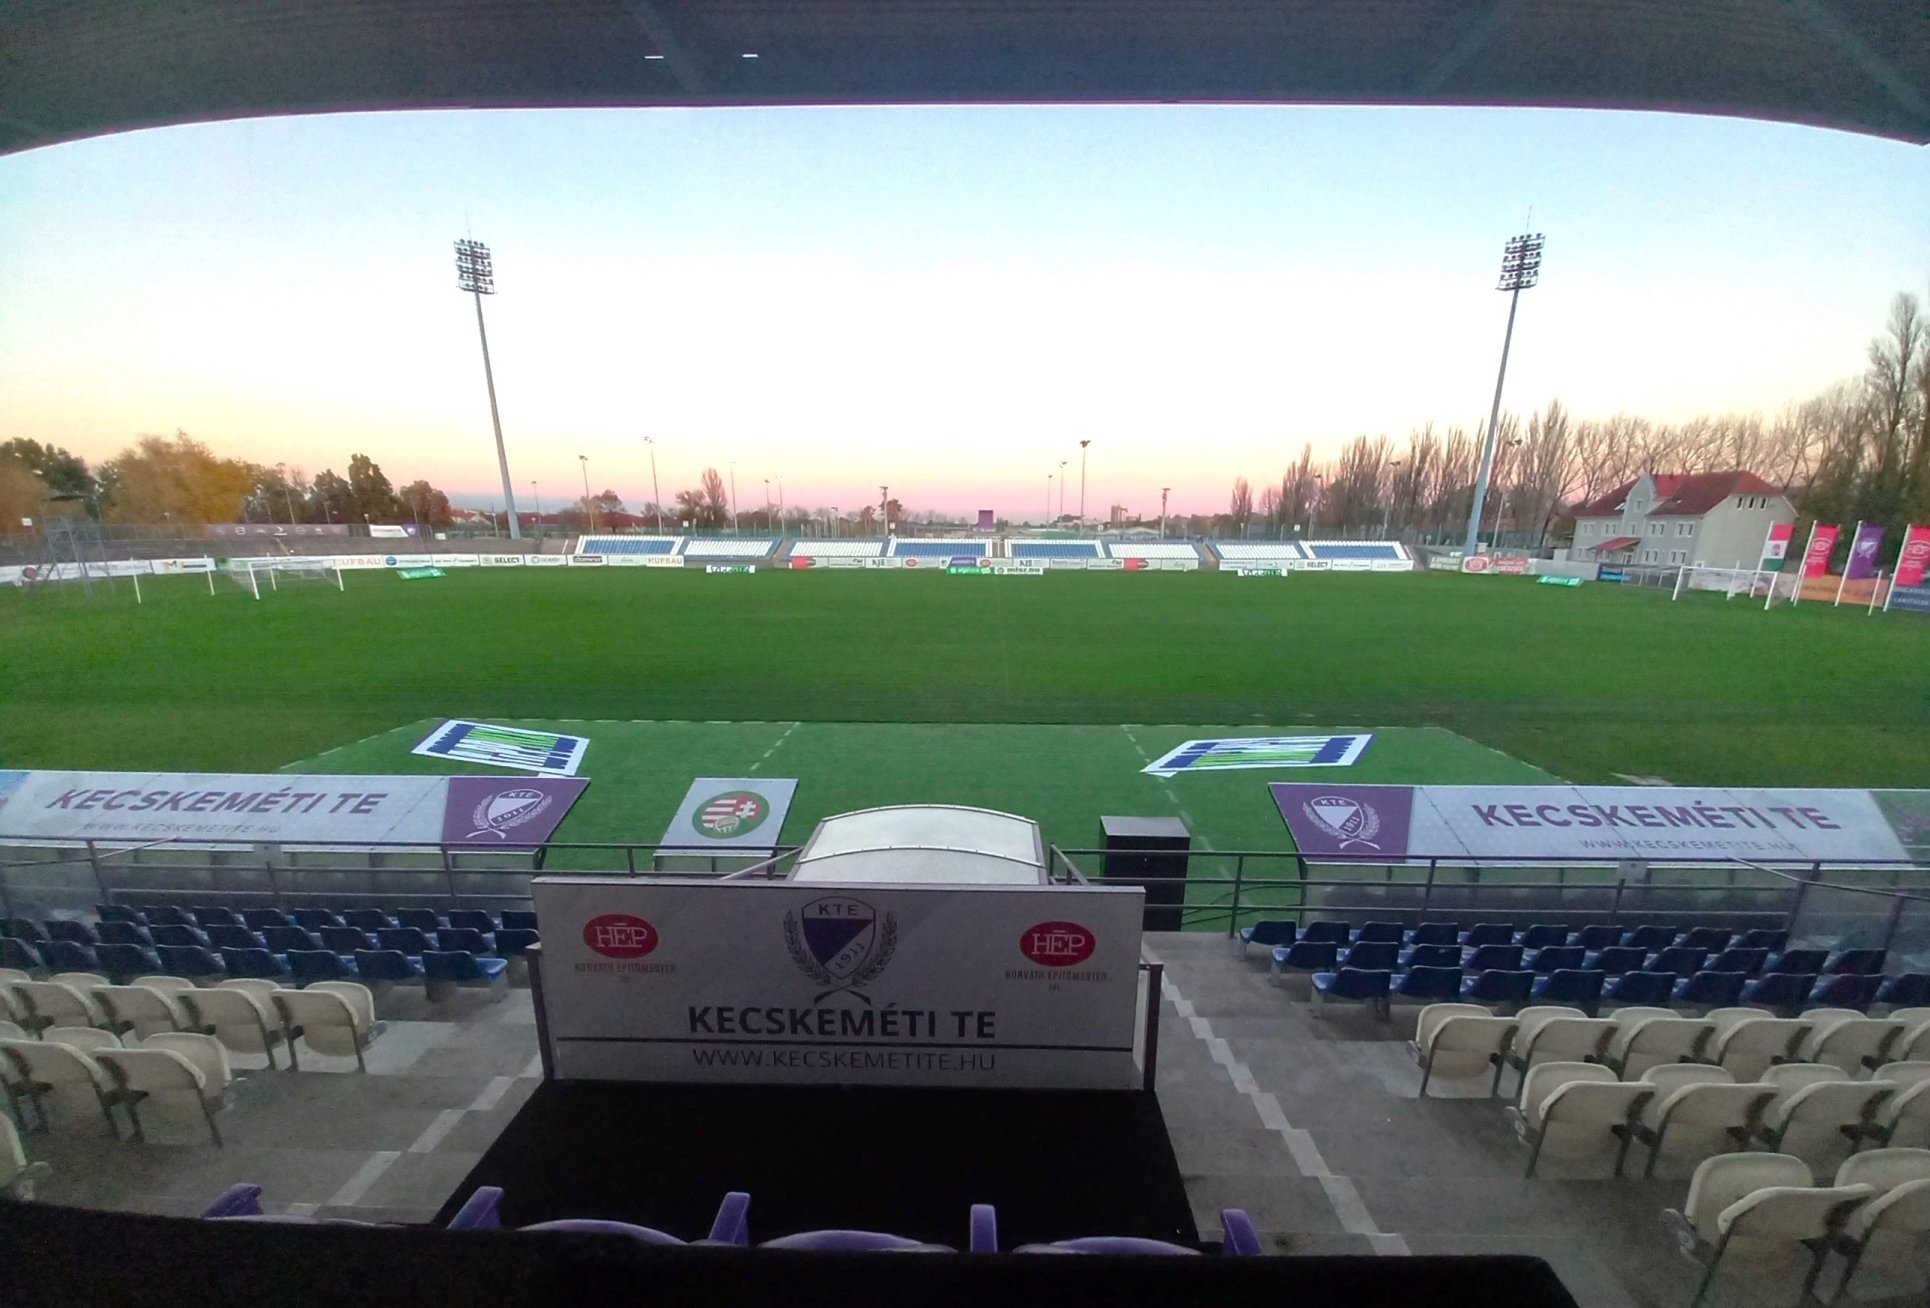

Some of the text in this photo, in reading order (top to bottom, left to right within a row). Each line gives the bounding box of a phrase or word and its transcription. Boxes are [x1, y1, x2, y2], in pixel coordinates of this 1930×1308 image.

[44, 787, 389, 814] KECSKEMÉTI TE
[1320, 798, 1347, 806] KTE
[497, 806, 525, 822] 1911
[1343, 816, 1361, 831] 1911
[1470, 800, 1842, 830] KECSKEMÉTI TE
[818, 903, 859, 917] KTE
[834, 941, 867, 969] 1911
[687, 1001, 996, 1039] KECSKEMÉTI TE
[692, 1048, 997, 1071] WWW.KECSKEMETITE.HU
